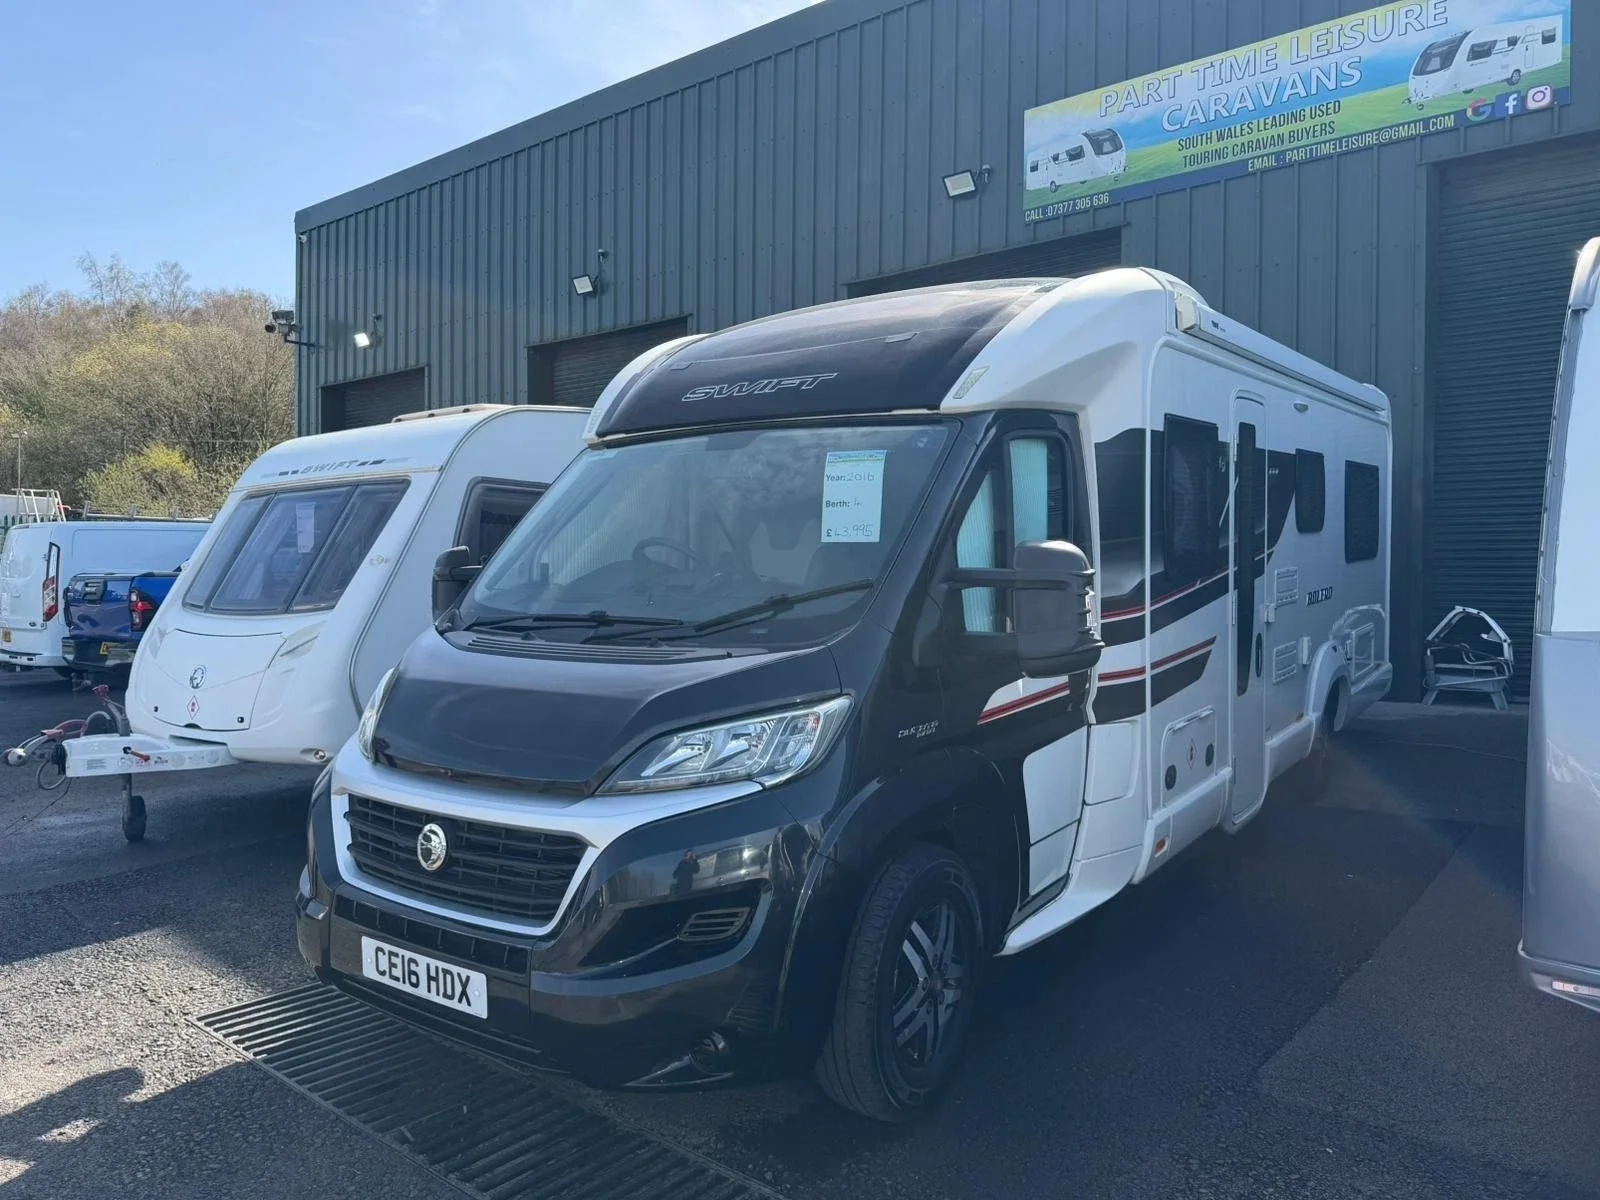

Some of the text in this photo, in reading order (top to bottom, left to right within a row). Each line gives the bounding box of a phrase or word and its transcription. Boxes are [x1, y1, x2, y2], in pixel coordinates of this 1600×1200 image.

[1100, 0, 1448, 117] PART TIME LEISURE
[1161, 55, 1363, 133] CARAVANS
[1177, 99, 1341, 152] SOUTH WALES LEADING USED
[1183, 120, 1336, 168] TOURING CARAVAN BUYERS
[1248, 155, 1278, 172] EMAIL
[1285, 114, 1455, 163] PARTTIMELEISURE@GMAIL.COM
[1076, 196, 1091, 210] 305
[1093, 192, 1110, 206] 636
[682, 372, 840, 402] SWIFT
[825, 499, 850, 508] Berth:
[374, 946, 472, 1008] CE16 HDX
